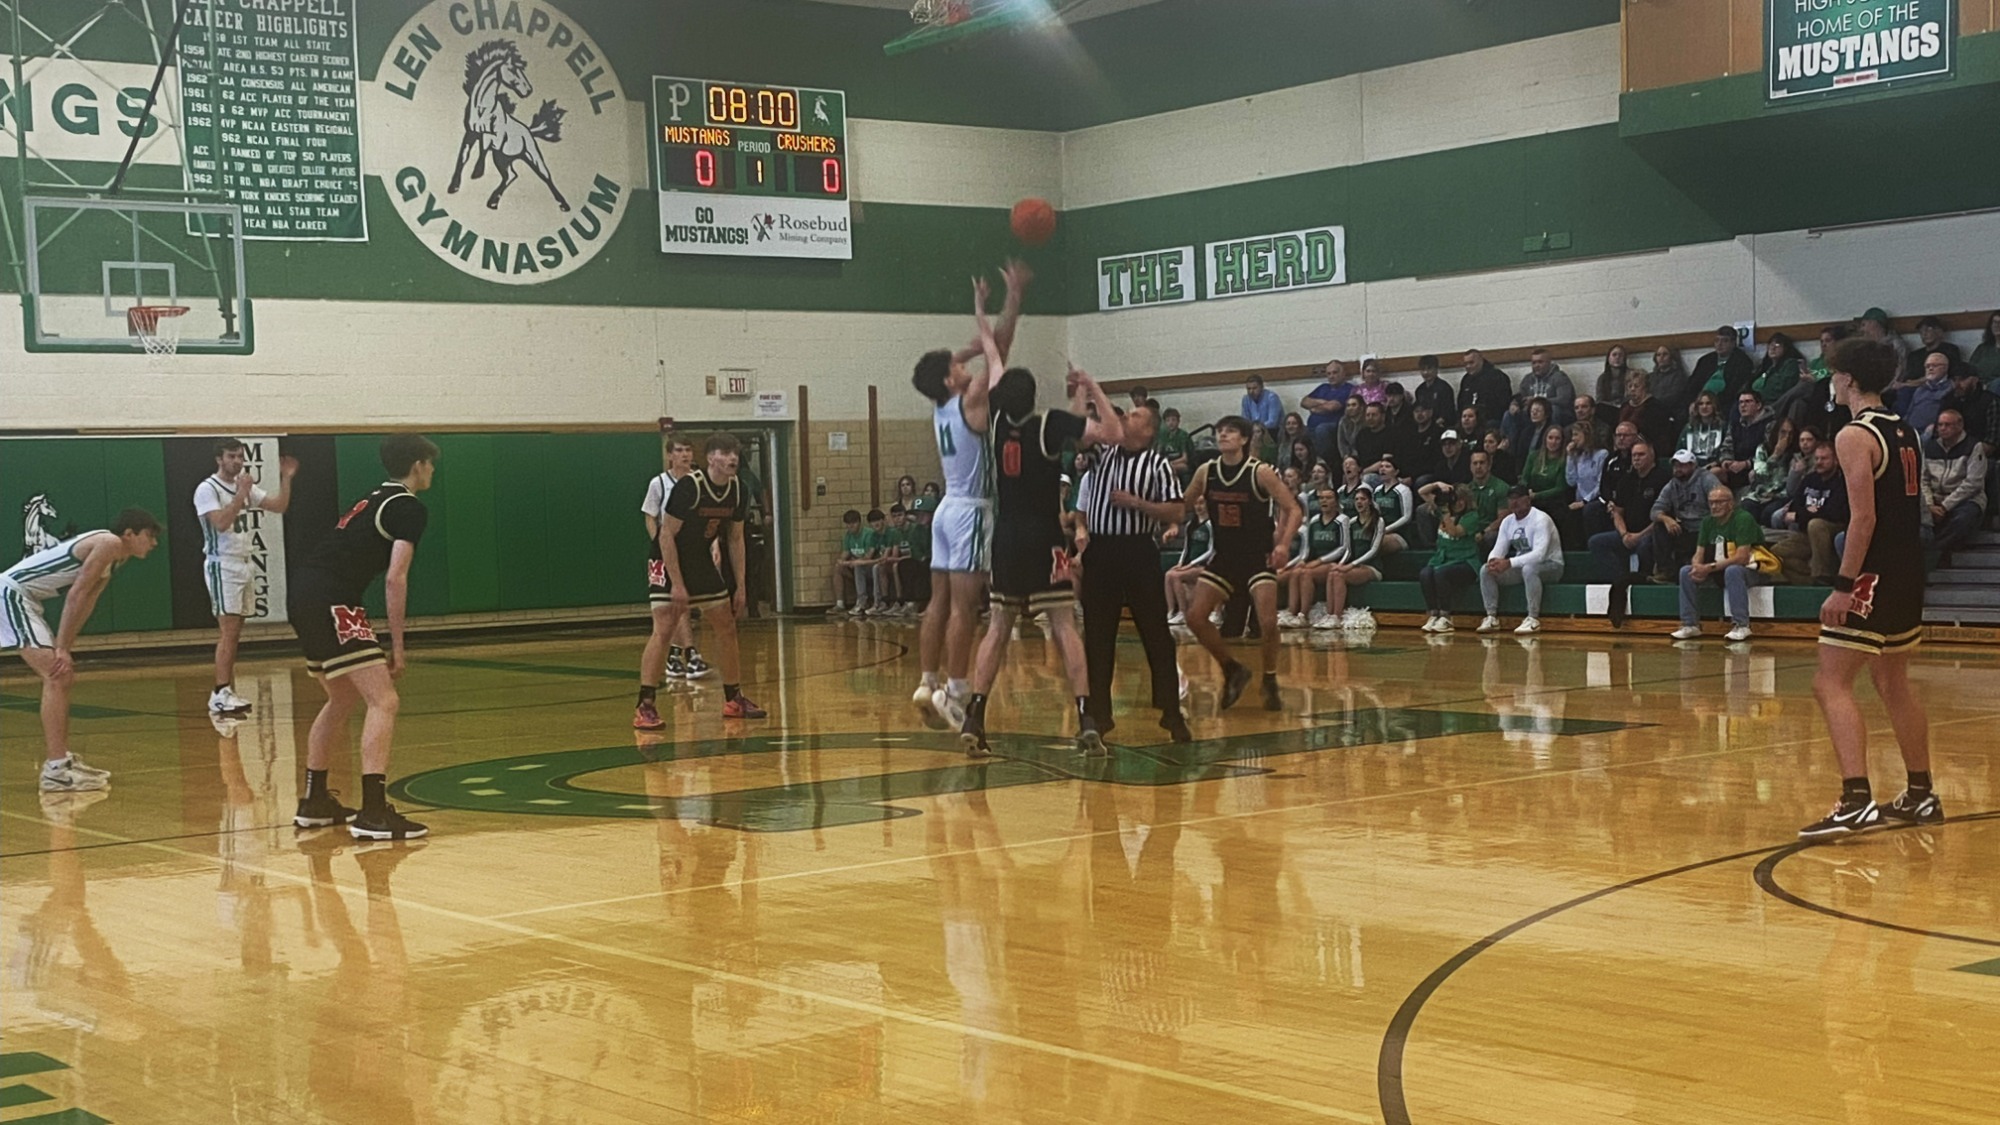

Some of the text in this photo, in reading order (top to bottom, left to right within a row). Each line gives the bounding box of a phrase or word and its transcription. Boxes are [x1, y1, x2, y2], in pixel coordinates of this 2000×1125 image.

[257, 14, 347, 38] HIGHLIGHTS
[1797, 1, 1920, 39] HOME OF THE
[233, 35, 247, 45] 1ST
[254, 36, 278, 47] TEAM
[284, 39, 300, 49] ALL
[306, 40, 331, 51] STATE
[1777, 22, 1941, 81] MUSTANGS
[255, 51, 286, 62] HIGHEST
[290, 53, 319, 64] CAREER
[322, 55, 350, 66] SCORER
[385, 0, 616, 115] LEN CHAPPELL
[223, 62, 246, 73] AREA
[271, 66, 284, 76] 53
[310, 68, 319, 78] IN
[322, 70, 328, 79] A
[331, 70, 354, 80] GAME
[241, 78, 284, 90] CONSENSUS
[291, 81, 306, 91] ALL
[312, 82, 351, 94] AMERICAN
[183, 87, 205, 98] 1961
[222, 89, 235, 100] 62
[240, 92, 257, 102] ACC
[262, 93, 293, 105] PLAYER
[298, 95, 308, 105] OF
[314, 95, 329, 107] THE
[334, 98, 355, 108] YEAR
[668, 82, 690, 121] P
[709, 86, 795, 126] 08:00
[191, 102, 213, 113] 1961
[231, 105, 244, 115] 62
[250, 107, 268, 117] MVP
[274, 108, 291, 118] ACC
[297, 109, 350, 121] TOURNAMENT
[188, 116, 212, 127] 1962
[242, 120, 266, 131] NCAA
[271, 122, 310, 133] EASTERN
[315, 124, 354, 136] REGIONAL
[221, 132, 327, 147] 962 NCAA FINAL FOUR
[664, 126, 836, 153] MUSTANGS CRUSHERS
[737, 140, 771, 154] PERIOD
[193, 145, 209, 155] ACC
[230, 147, 261, 158] RANKED
[265, 150, 276, 160] OF
[282, 150, 297, 160] TOP
[302, 151, 315, 161] 50
[320, 152, 352, 163] PLAYERS
[268, 164, 295, 174] GREATEST
[301, 165, 326, 175] COLLEGE
[331, 166, 356, 176] PLAYERS
[695, 149, 840, 193] 0 1 0
[259, 177, 276, 188] NBA
[282, 178, 308, 188] DRAFT
[314, 179, 342, 190] CHOICE
[240, 190, 260, 200] YORK
[264, 192, 291, 202] KNICKS
[295, 193, 325, 203] SCORING
[329, 194, 358, 204] LEADER
[242, 204, 340, 217] NBA ALL STAR TEAM
[695, 207, 714, 224] GO
[244, 218, 267, 229] YEAR
[272, 219, 290, 229] NBA
[295, 221, 327, 231] CAREER
[395, 166, 621, 275] GYMNASIUM
[778, 213, 848, 232] Rosebud
[665, 225, 749, 245] MUSTANGS!
[779, 232, 848, 245] Mining Company
[1101, 229, 1336, 307] THE HERD
[729, 378, 746, 392] EXIT
[1003, 440, 1022, 477] 0
[241, 443, 270, 618] MUTANGS
[330, 604, 371, 634] M
